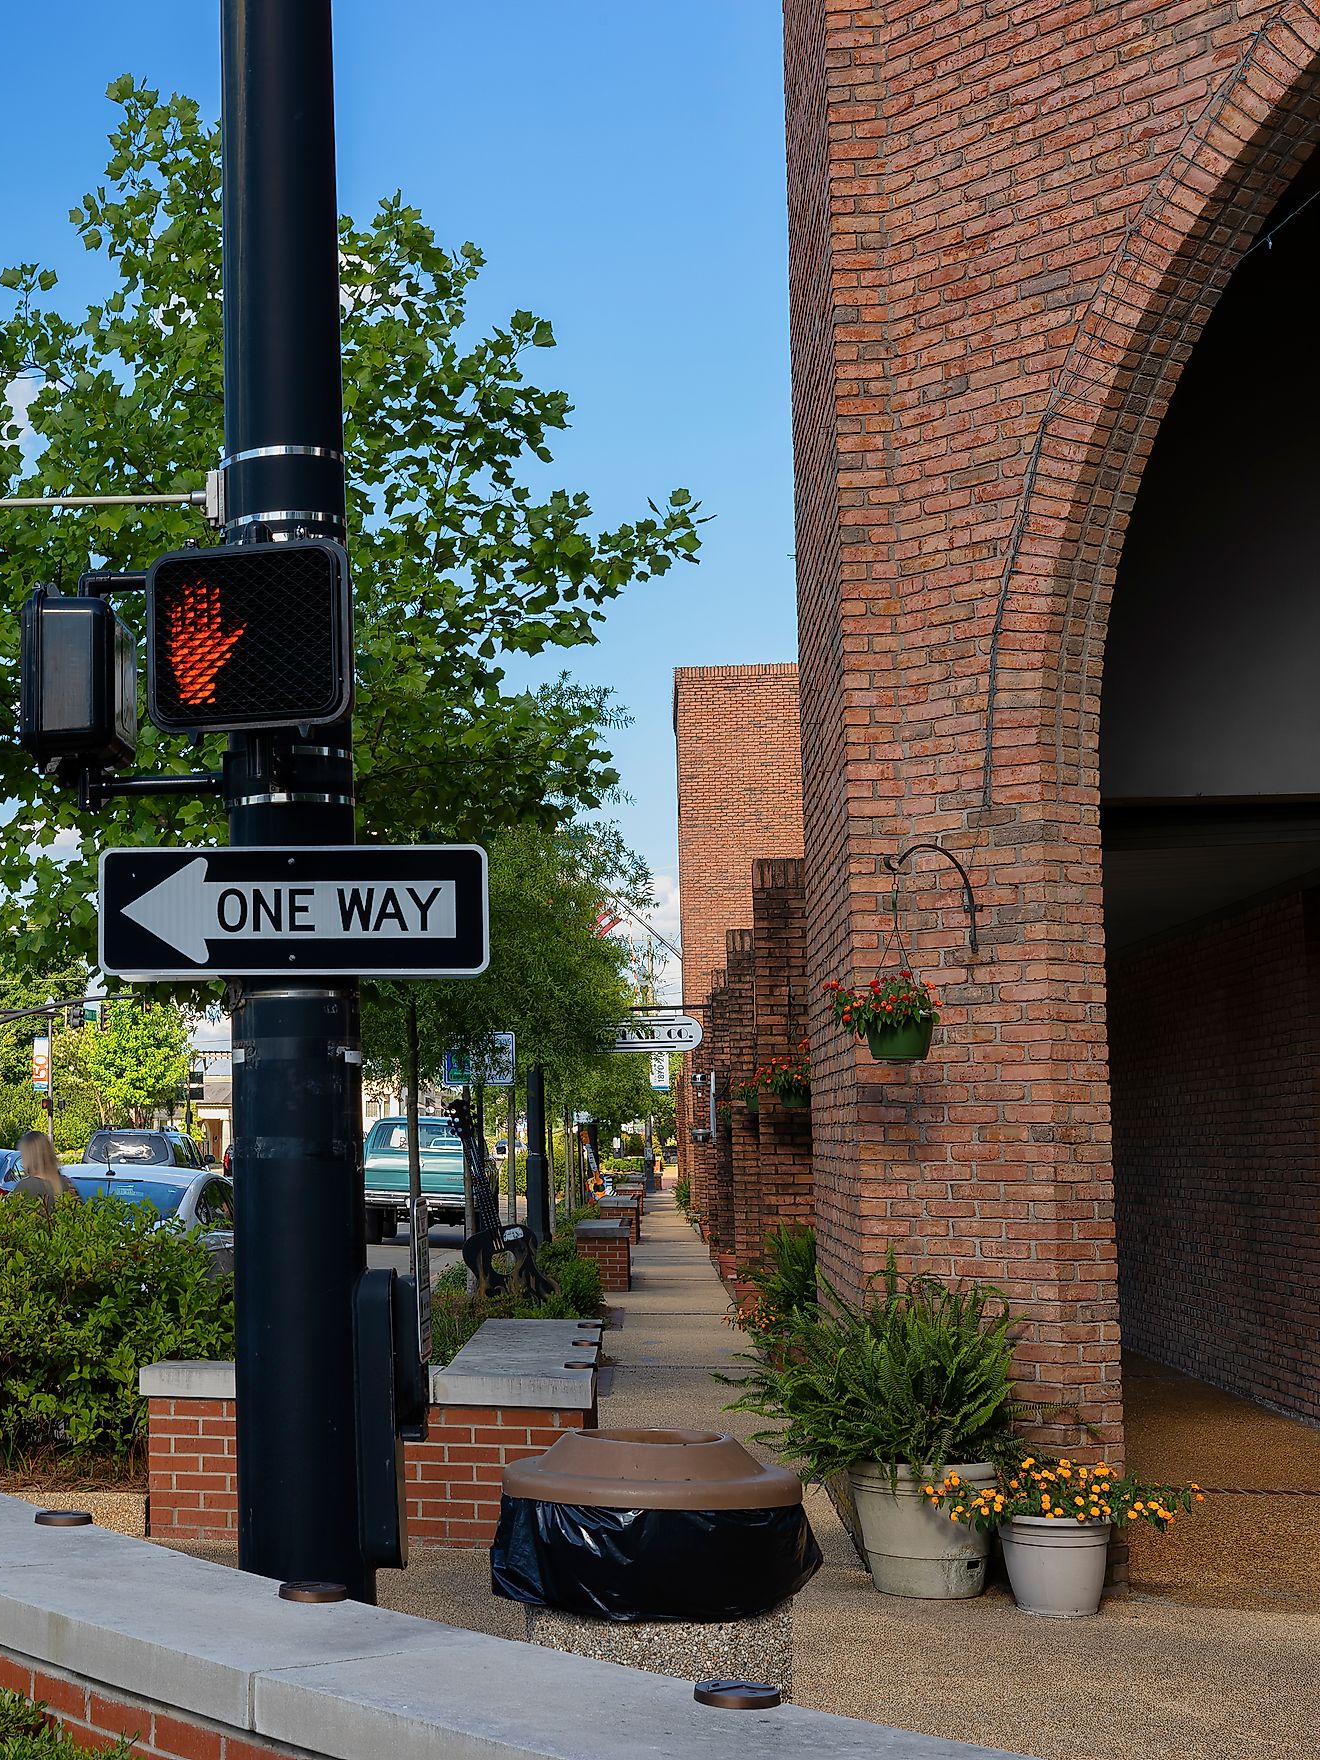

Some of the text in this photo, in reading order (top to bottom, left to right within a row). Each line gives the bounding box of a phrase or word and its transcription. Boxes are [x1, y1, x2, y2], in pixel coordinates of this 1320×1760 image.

[217, 887, 443, 933] ONE WAY
[666, 1028, 694, 1040] CO.
